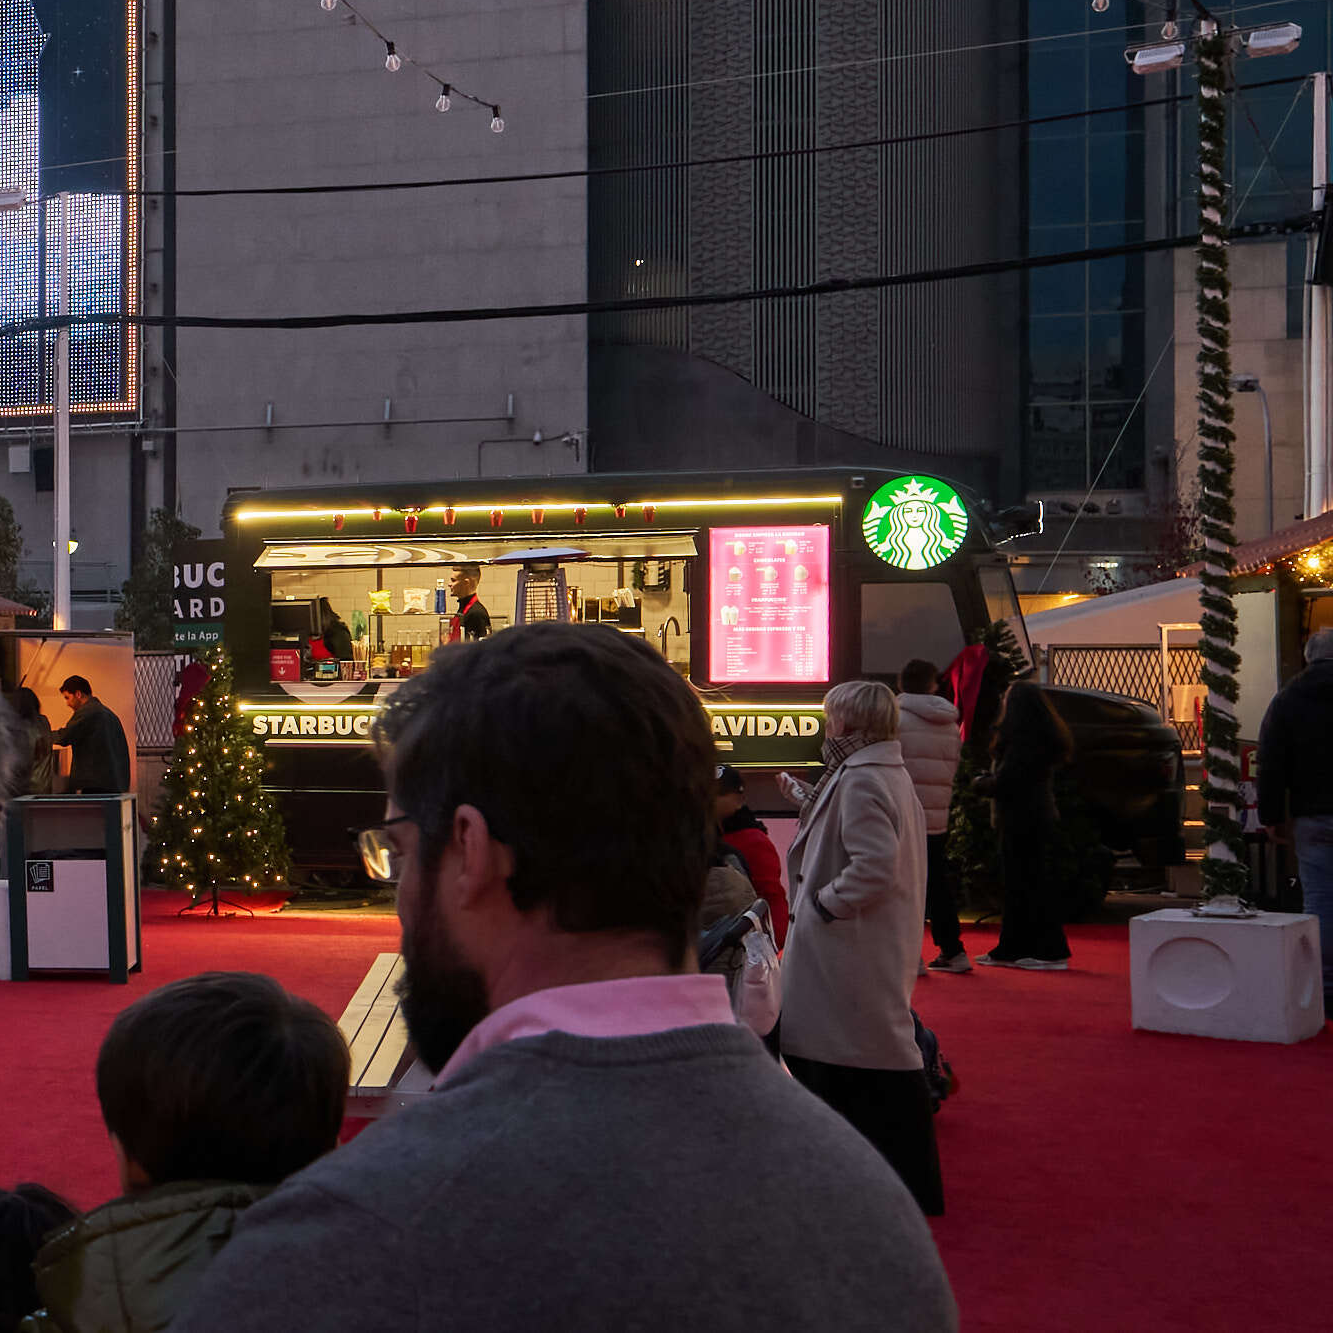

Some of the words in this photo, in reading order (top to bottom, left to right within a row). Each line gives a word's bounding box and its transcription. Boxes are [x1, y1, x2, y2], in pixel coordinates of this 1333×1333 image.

[188, 631, 196, 641] la
[199, 632, 219, 642] App
[252, 715, 377, 736] STARBUC
